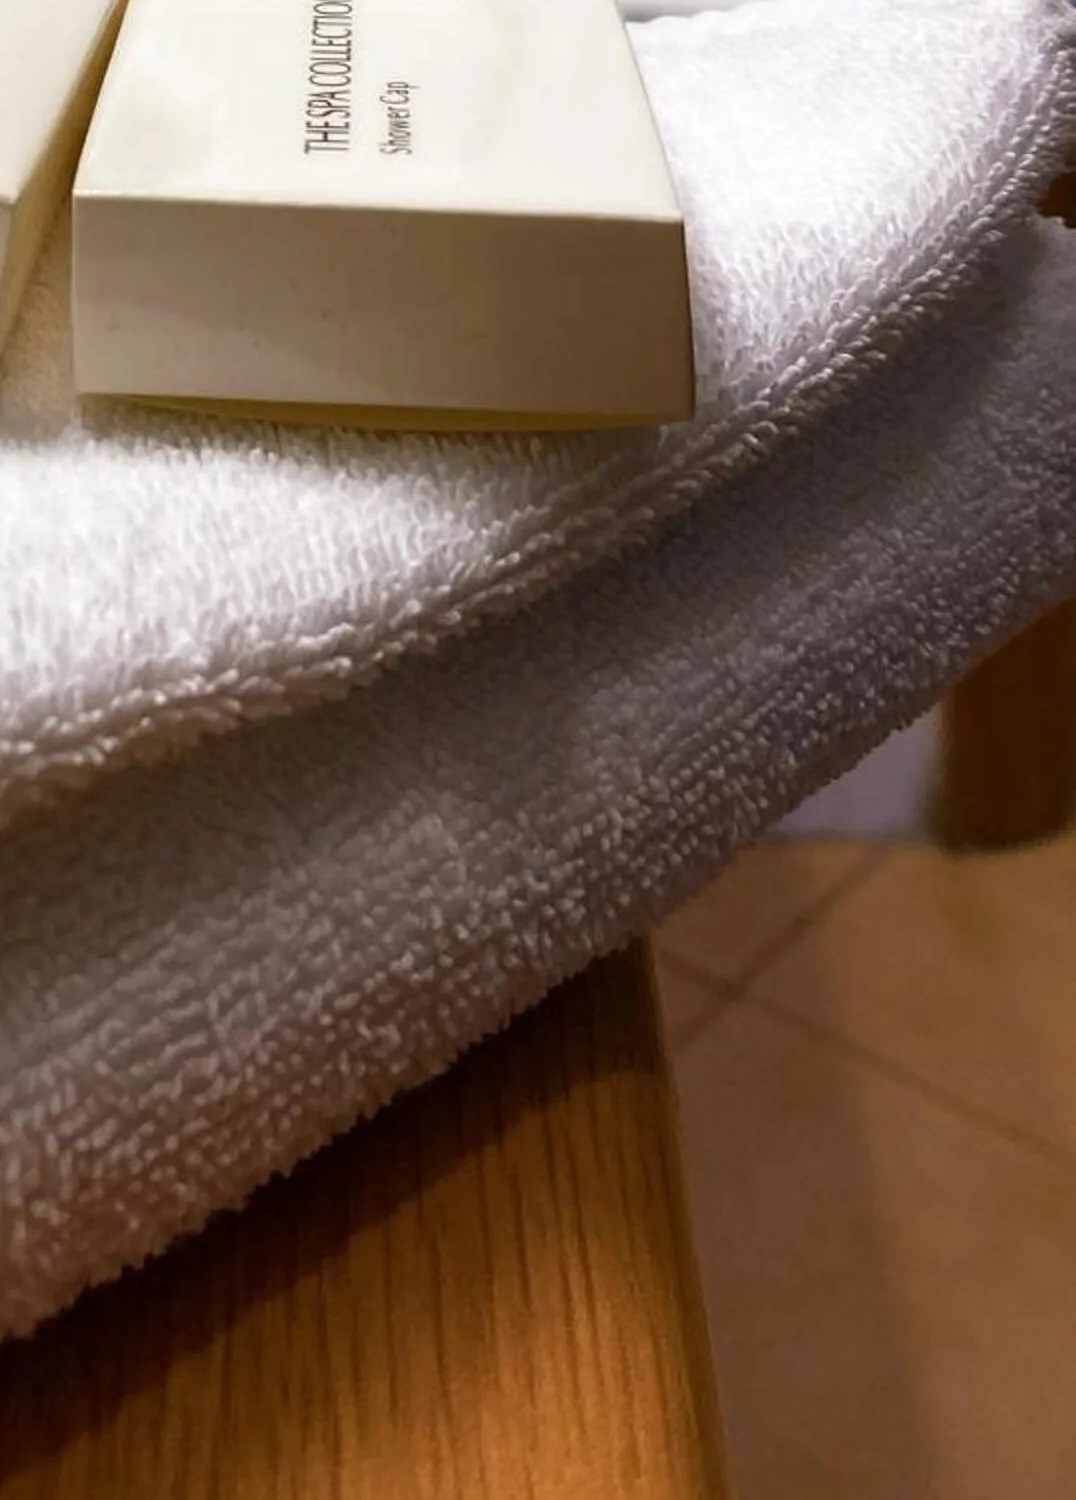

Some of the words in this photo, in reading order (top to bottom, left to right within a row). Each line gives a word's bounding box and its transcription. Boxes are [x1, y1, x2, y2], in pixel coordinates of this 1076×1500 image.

[305, 90, 352, 119] SPA
[380, 81, 421, 104] Cap
[303, 120, 350, 154] THE
[378, 105, 412, 155] Shower
